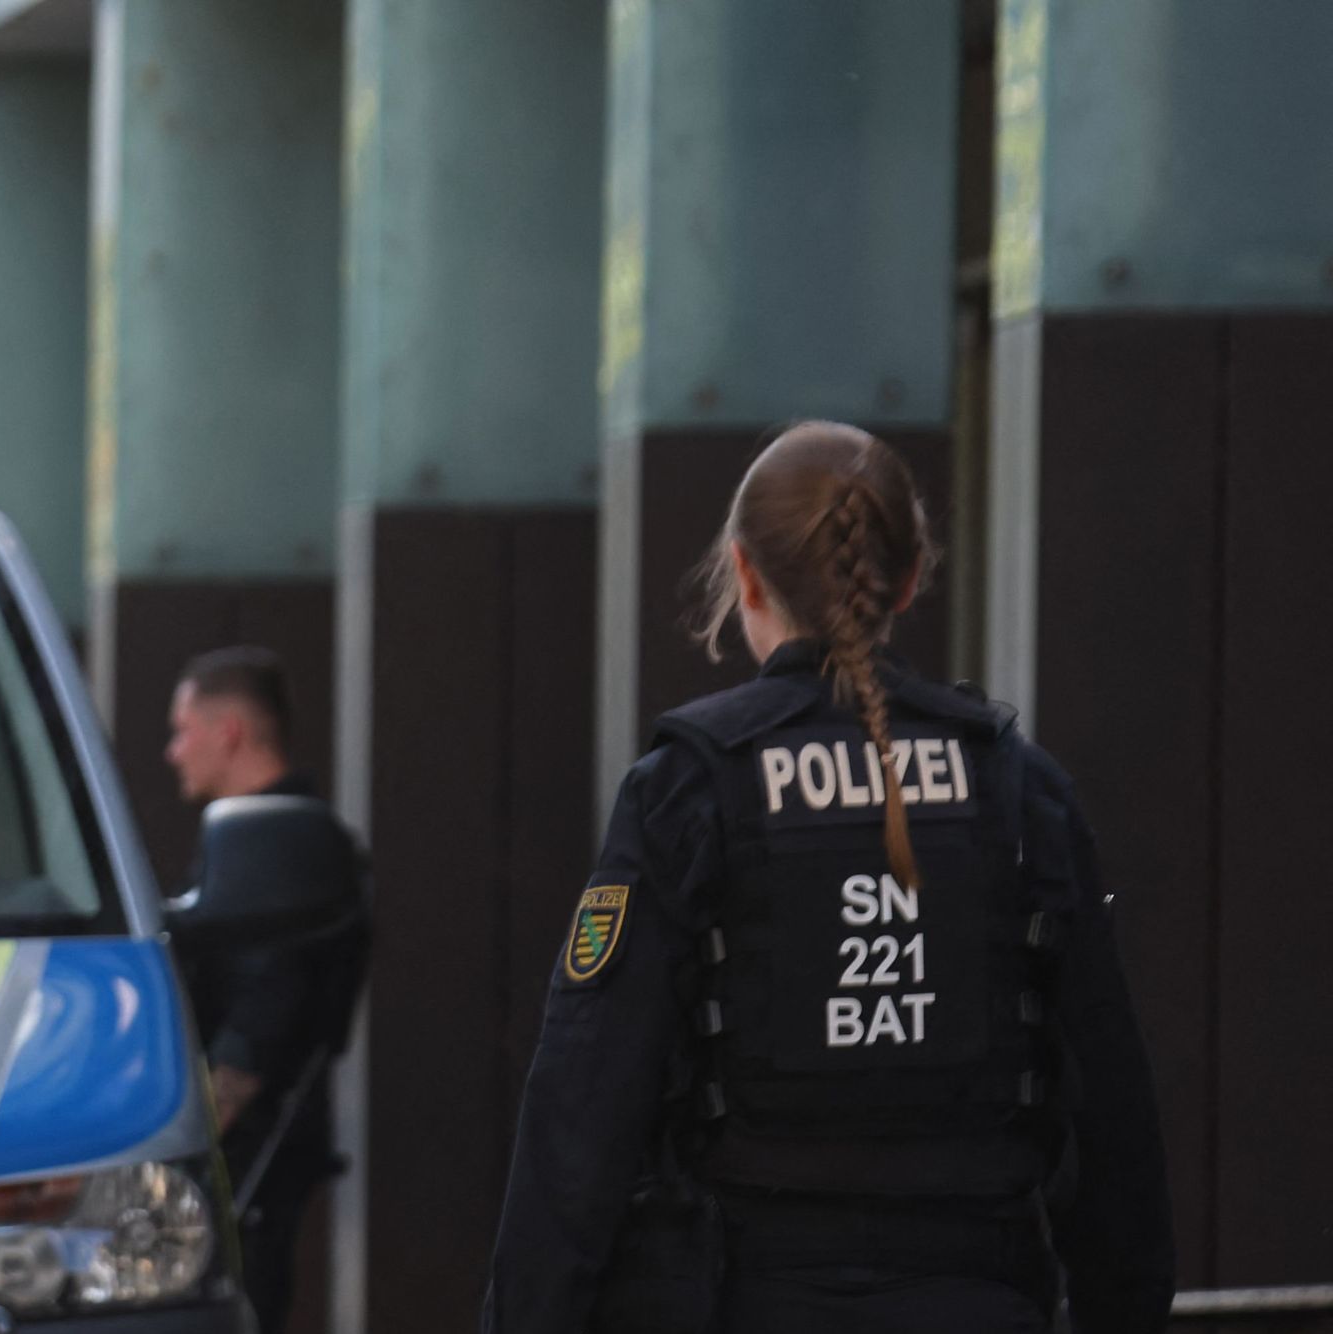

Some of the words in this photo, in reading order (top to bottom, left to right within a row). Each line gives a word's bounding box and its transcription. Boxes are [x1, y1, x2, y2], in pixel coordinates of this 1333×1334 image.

[761, 737, 969, 813] POLIZEI
[582, 893, 625, 908] POLIZEI
[840, 873, 920, 927] SN
[837, 932, 926, 987] 221
[825, 992, 936, 1048] BAT
